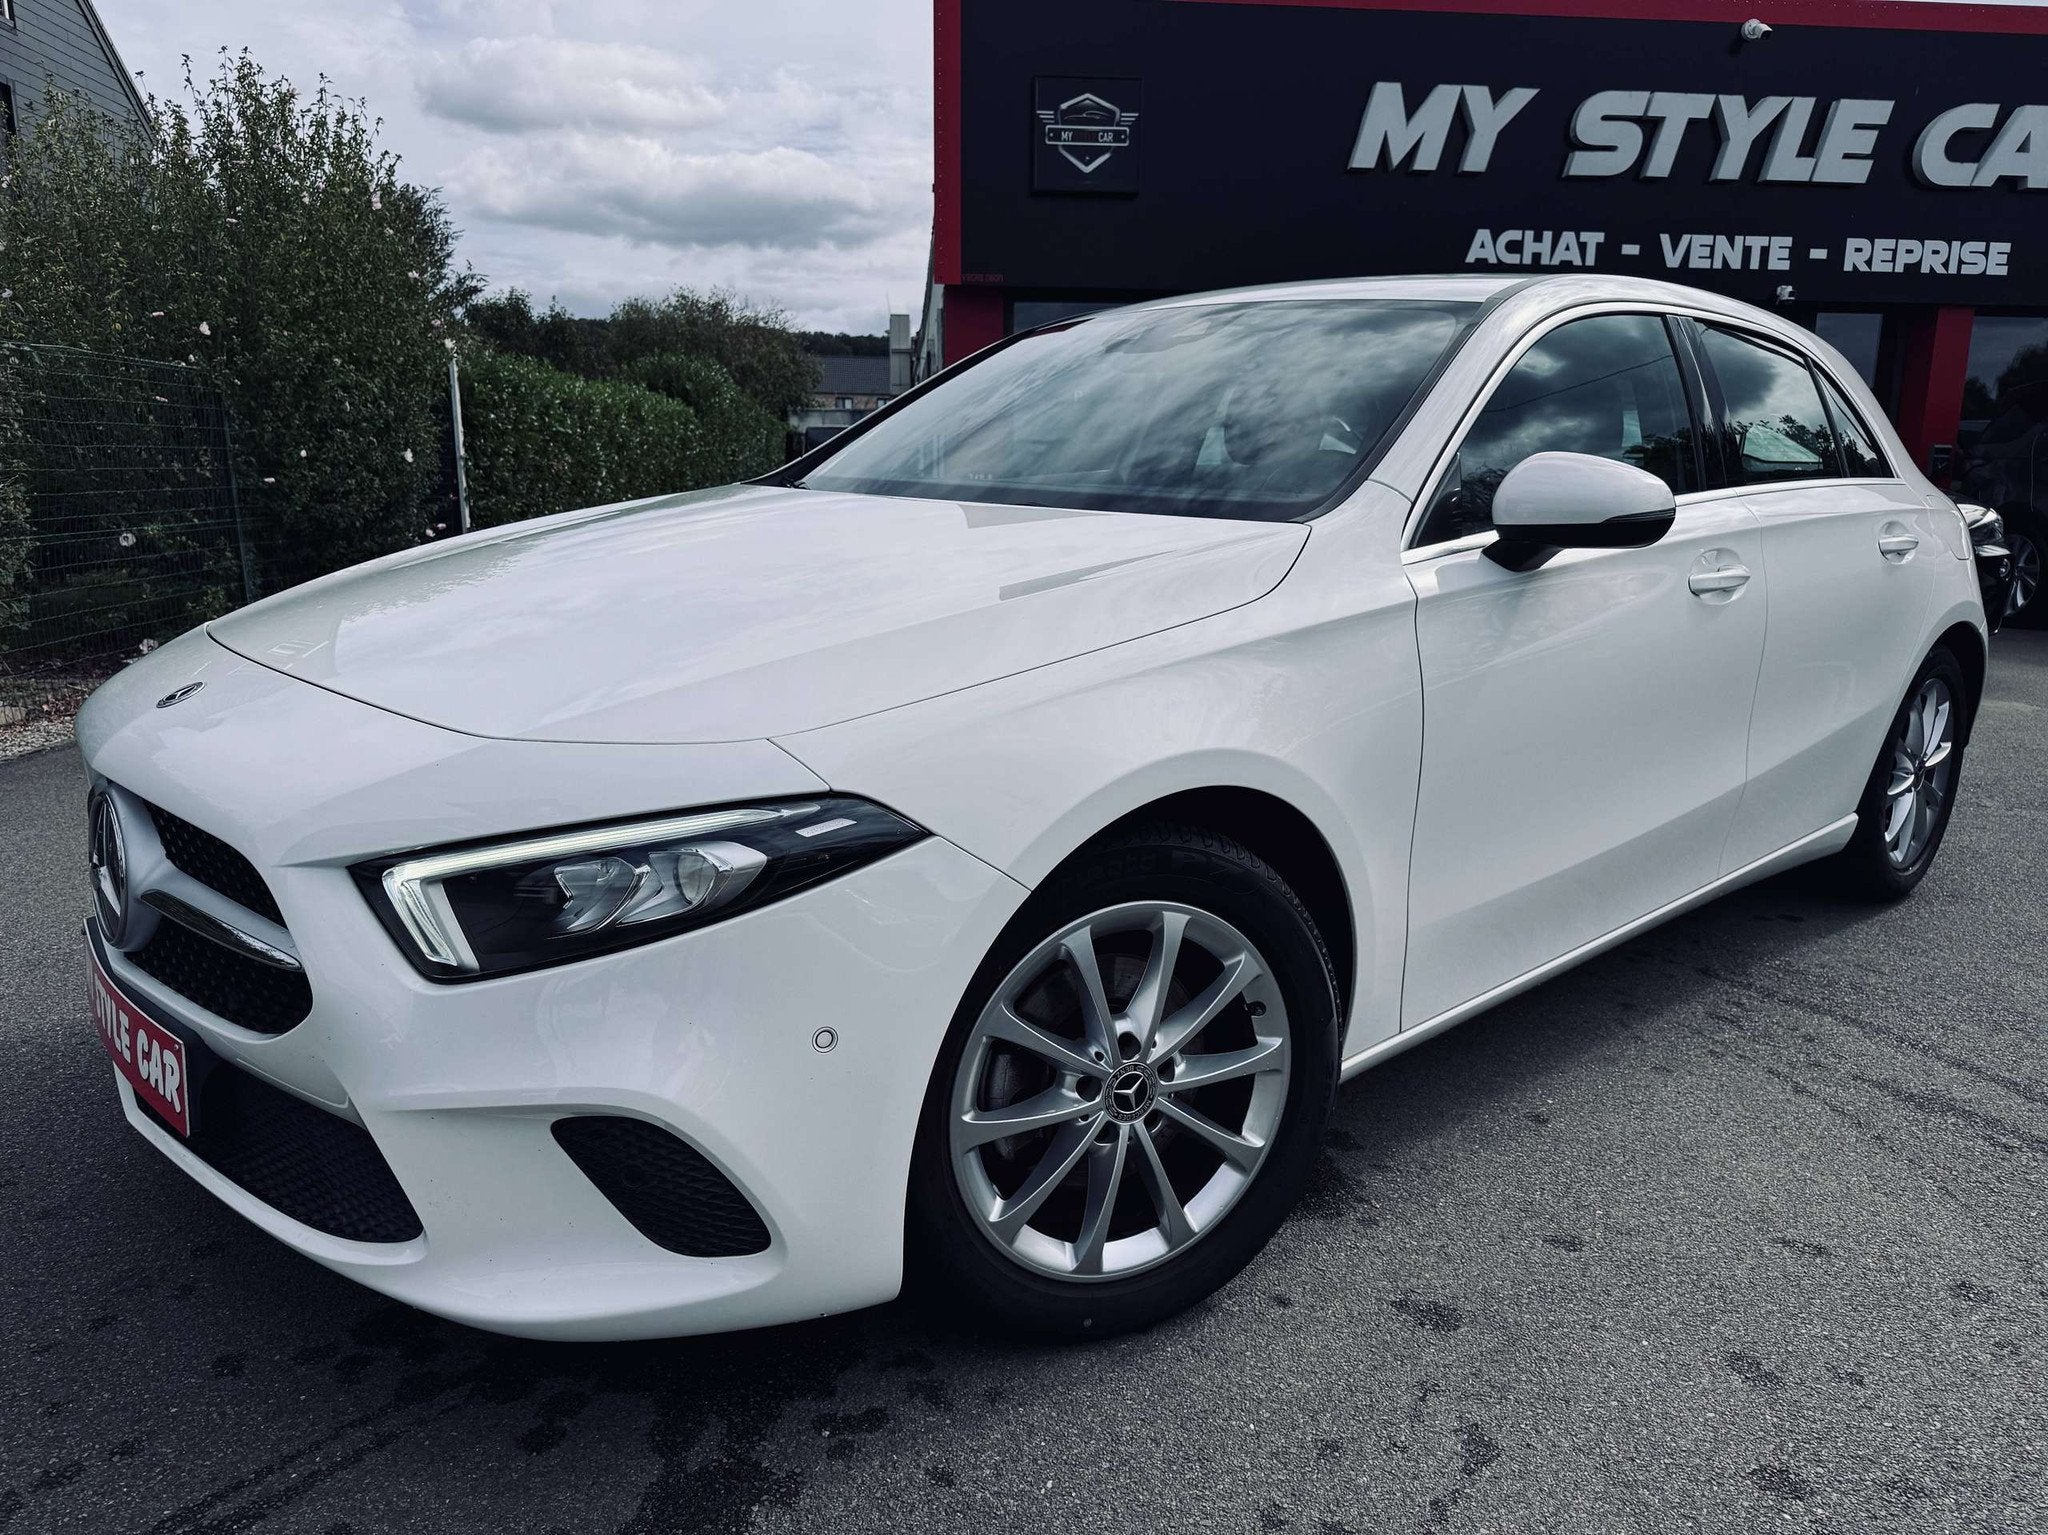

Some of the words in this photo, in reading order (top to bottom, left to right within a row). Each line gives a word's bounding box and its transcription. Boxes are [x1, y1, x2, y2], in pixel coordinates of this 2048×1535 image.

[1061, 131, 1073, 142] MY
[1098, 132, 1114, 143] CAR
[1348, 81, 1540, 173] MY
[1562, 90, 1895, 184] STYLE
[1465, 228, 1604, 266] ACHAT
[1660, 233, 1793, 270] VENTE
[1843, 237, 2012, 276] REPRISE
[136, 1028, 182, 1114] CAR
